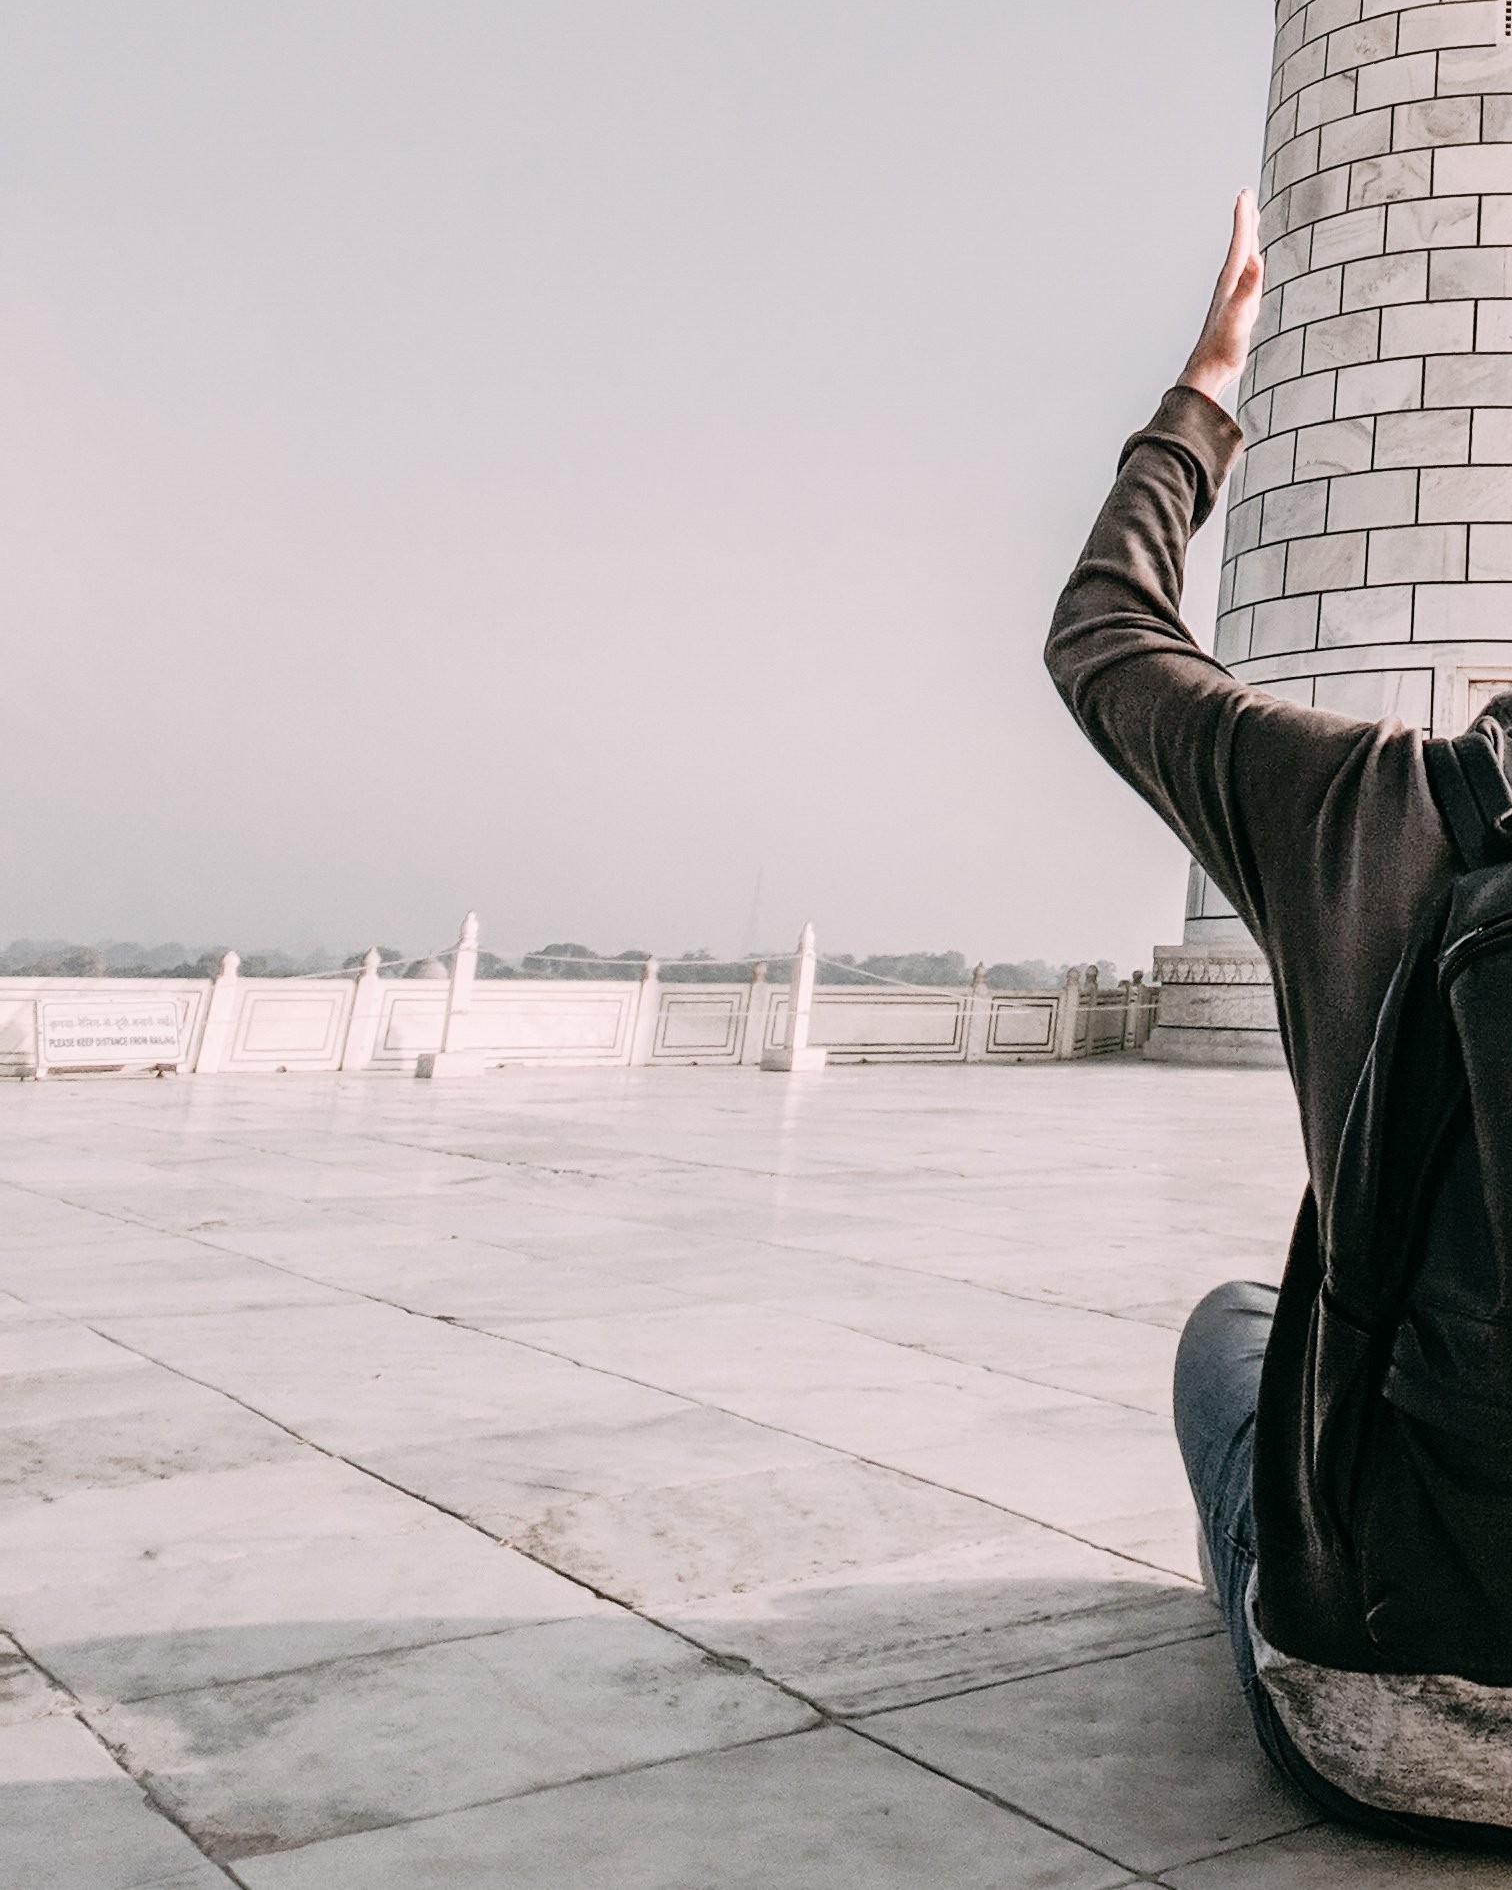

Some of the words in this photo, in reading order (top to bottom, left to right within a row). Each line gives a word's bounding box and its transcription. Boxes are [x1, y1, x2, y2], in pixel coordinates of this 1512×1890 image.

[49, 1038, 74, 1048] PLEASE
[77, 1037, 93, 1047] KEEP
[96, 1037, 127, 1047] DISTANCE
[130, 1036, 147, 1046] FROM
